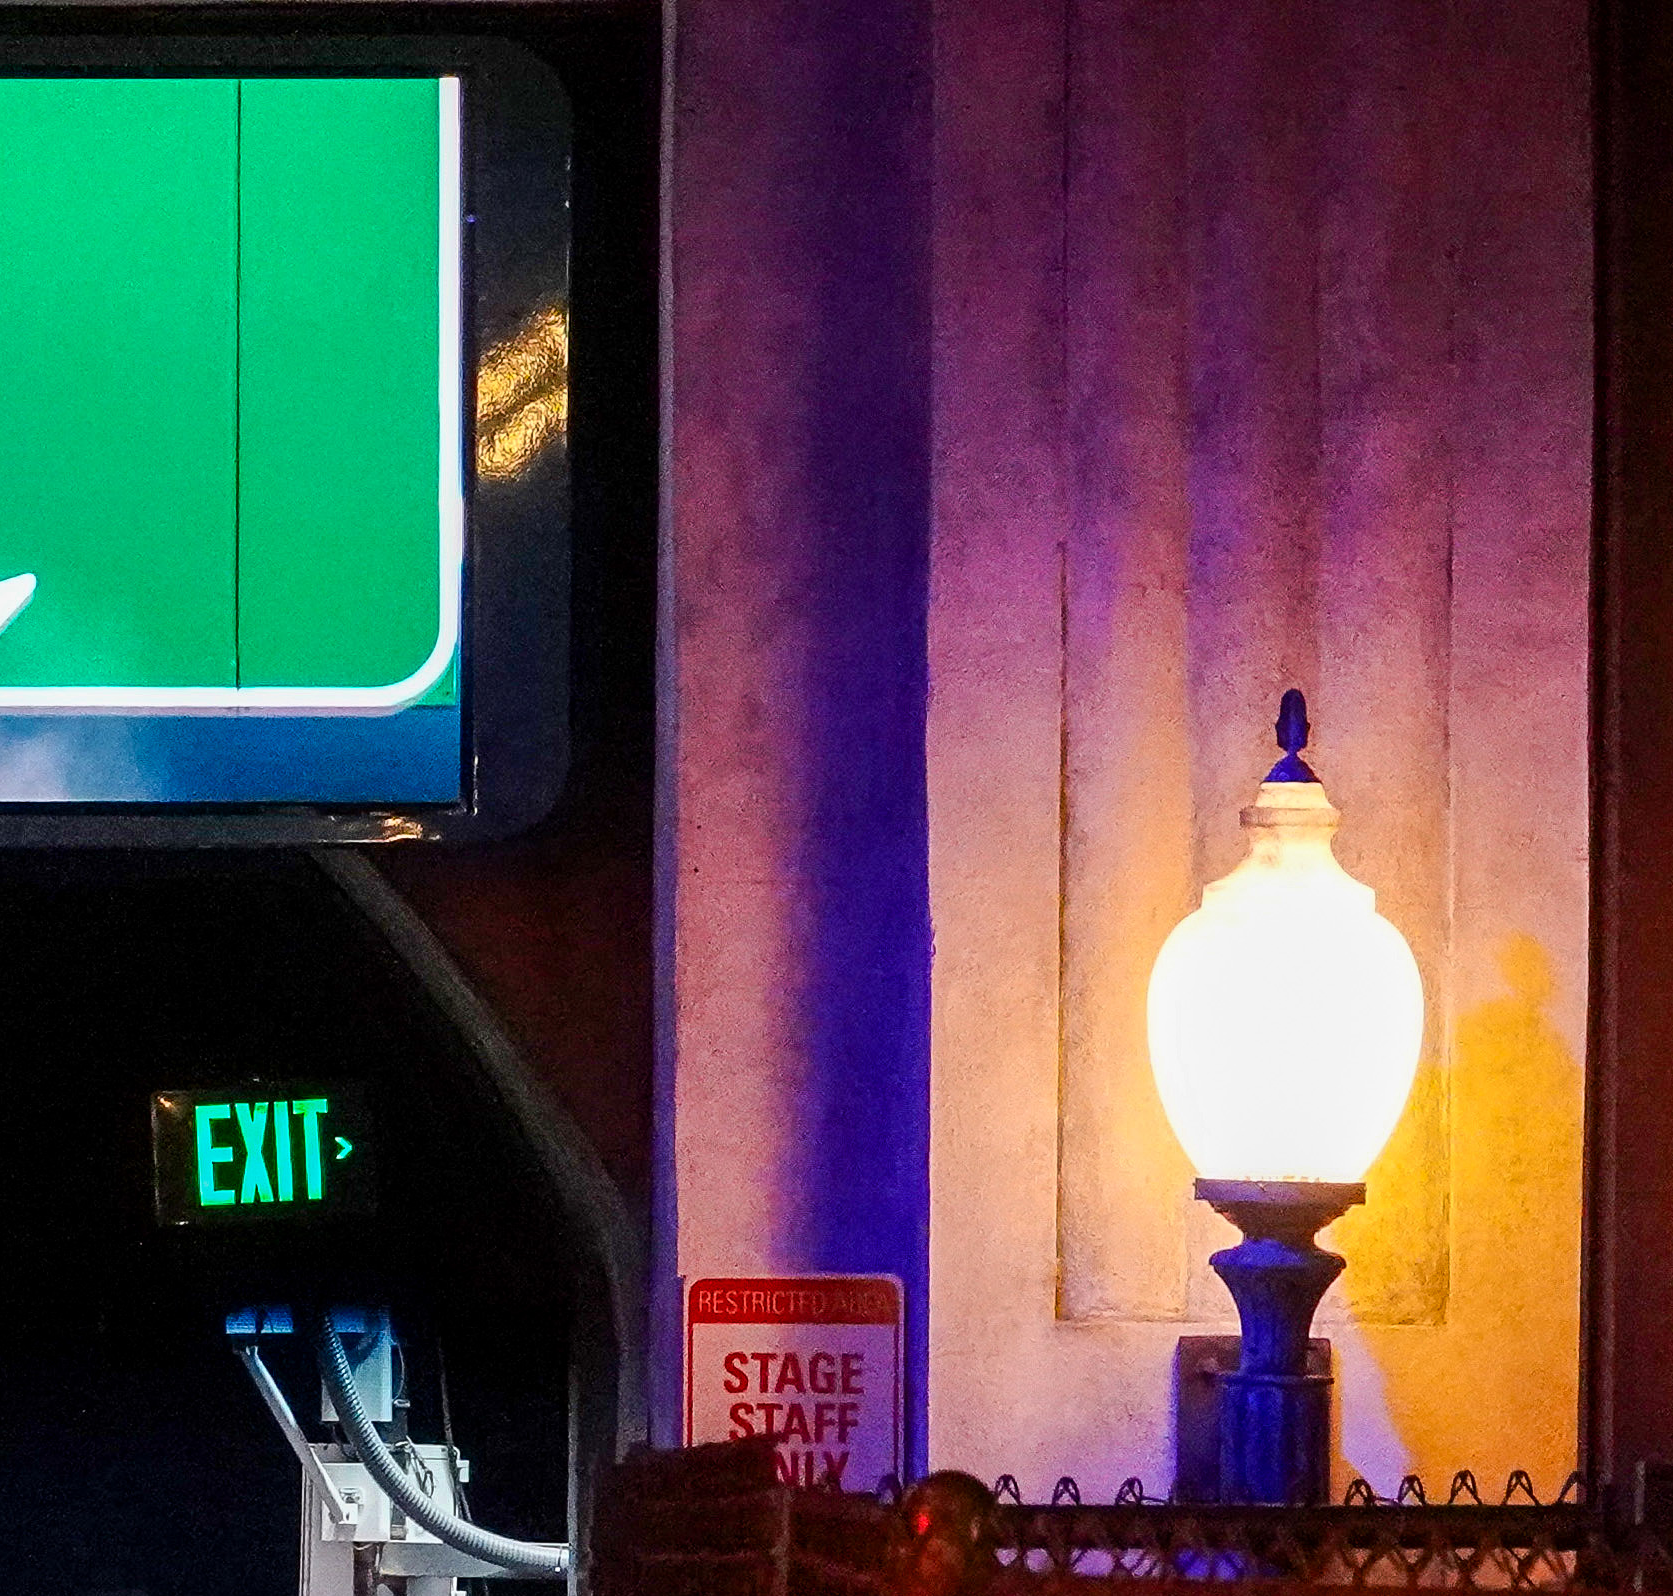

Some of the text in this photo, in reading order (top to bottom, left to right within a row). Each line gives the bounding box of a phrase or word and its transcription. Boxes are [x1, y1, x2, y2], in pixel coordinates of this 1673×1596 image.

[195, 1099, 328, 1206] EXIT
[698, 1289, 825, 1316] RESTRICTED
[723, 1352, 865, 1395] STAGE
[728, 1402, 860, 1445] STAFF
[773, 1450, 850, 1490] NLY
